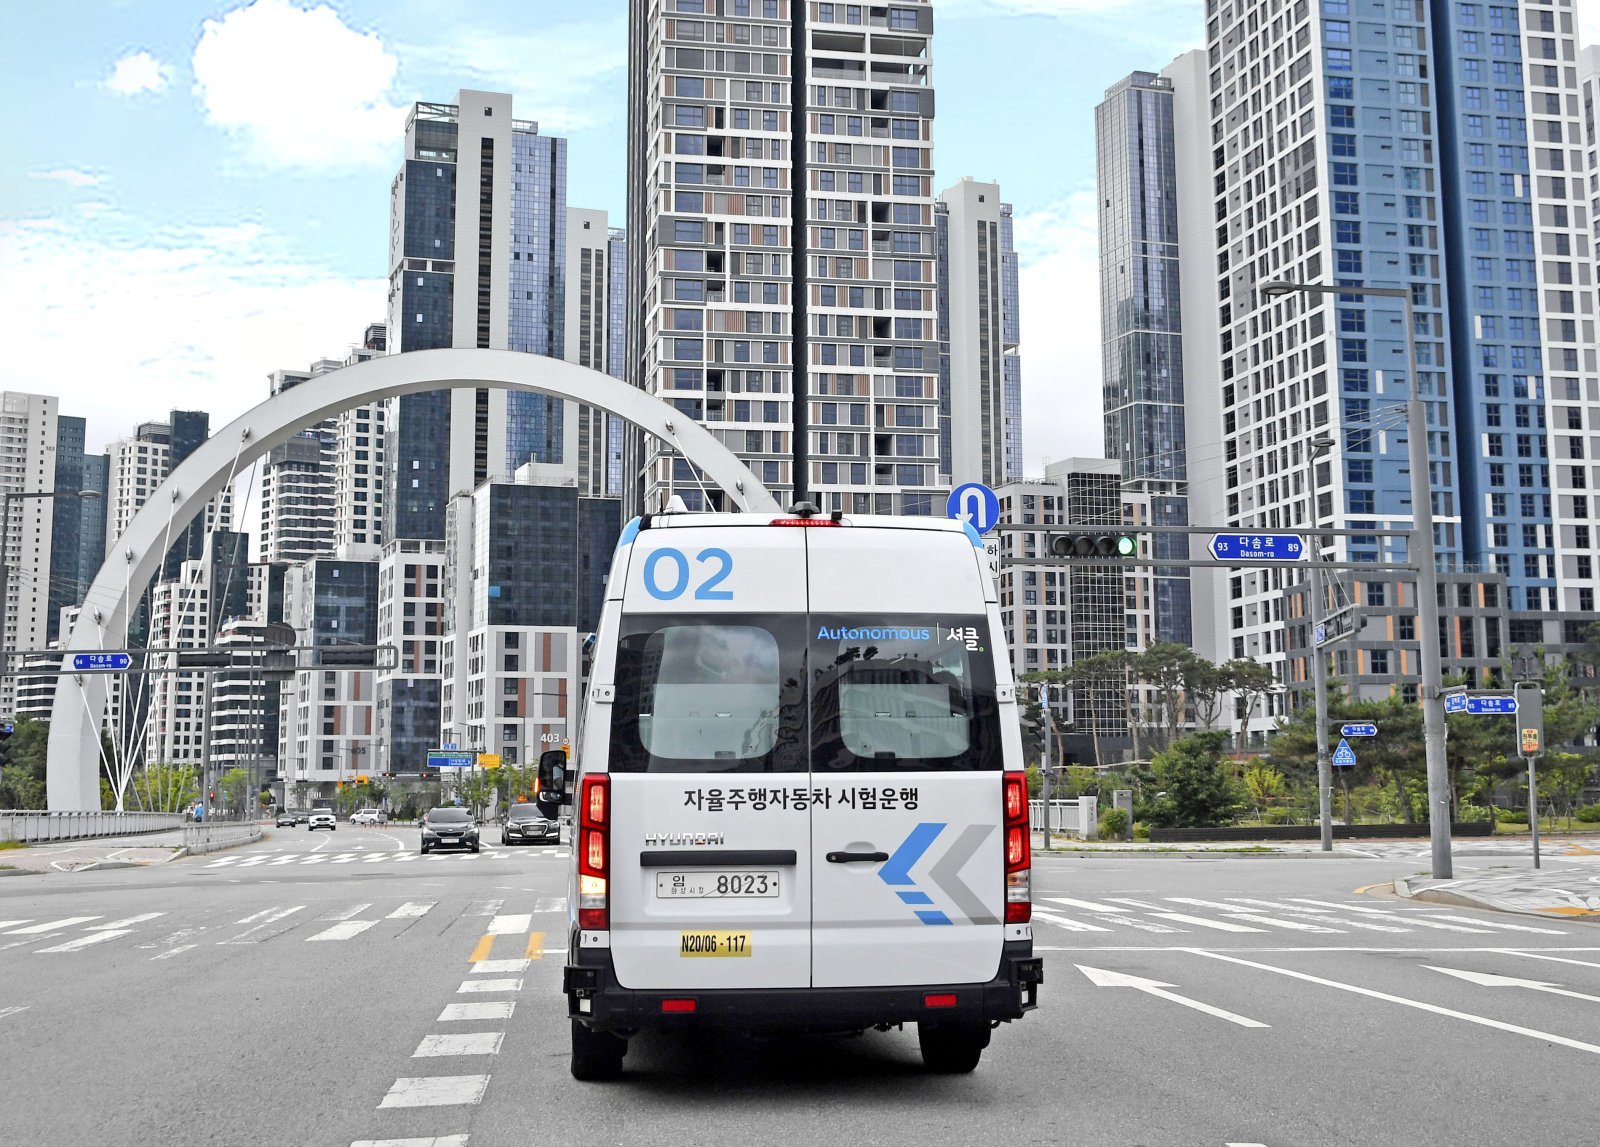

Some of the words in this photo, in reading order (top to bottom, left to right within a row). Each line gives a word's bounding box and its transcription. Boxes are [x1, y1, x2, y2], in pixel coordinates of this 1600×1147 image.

[1217, 542, 1228, 551] 93
[1239, 536, 1275, 549] 다솜로
[1287, 543, 1299, 553] 89
[643, 547, 734, 601] 02
[817, 625, 930, 640] Autonomous
[89, 655, 113, 663] 다솜로
[540, 733, 560, 743] 403
[684, 787, 832, 812] 자율주행자동차
[837, 787, 919, 810] 시험운행
[645, 832, 724, 846] HYUNDAI
[672, 875, 685, 887] 임
[717, 875, 768, 894] 8023
[681, 935, 717, 953] N20/06
[726, 935, 746, 952] 117
